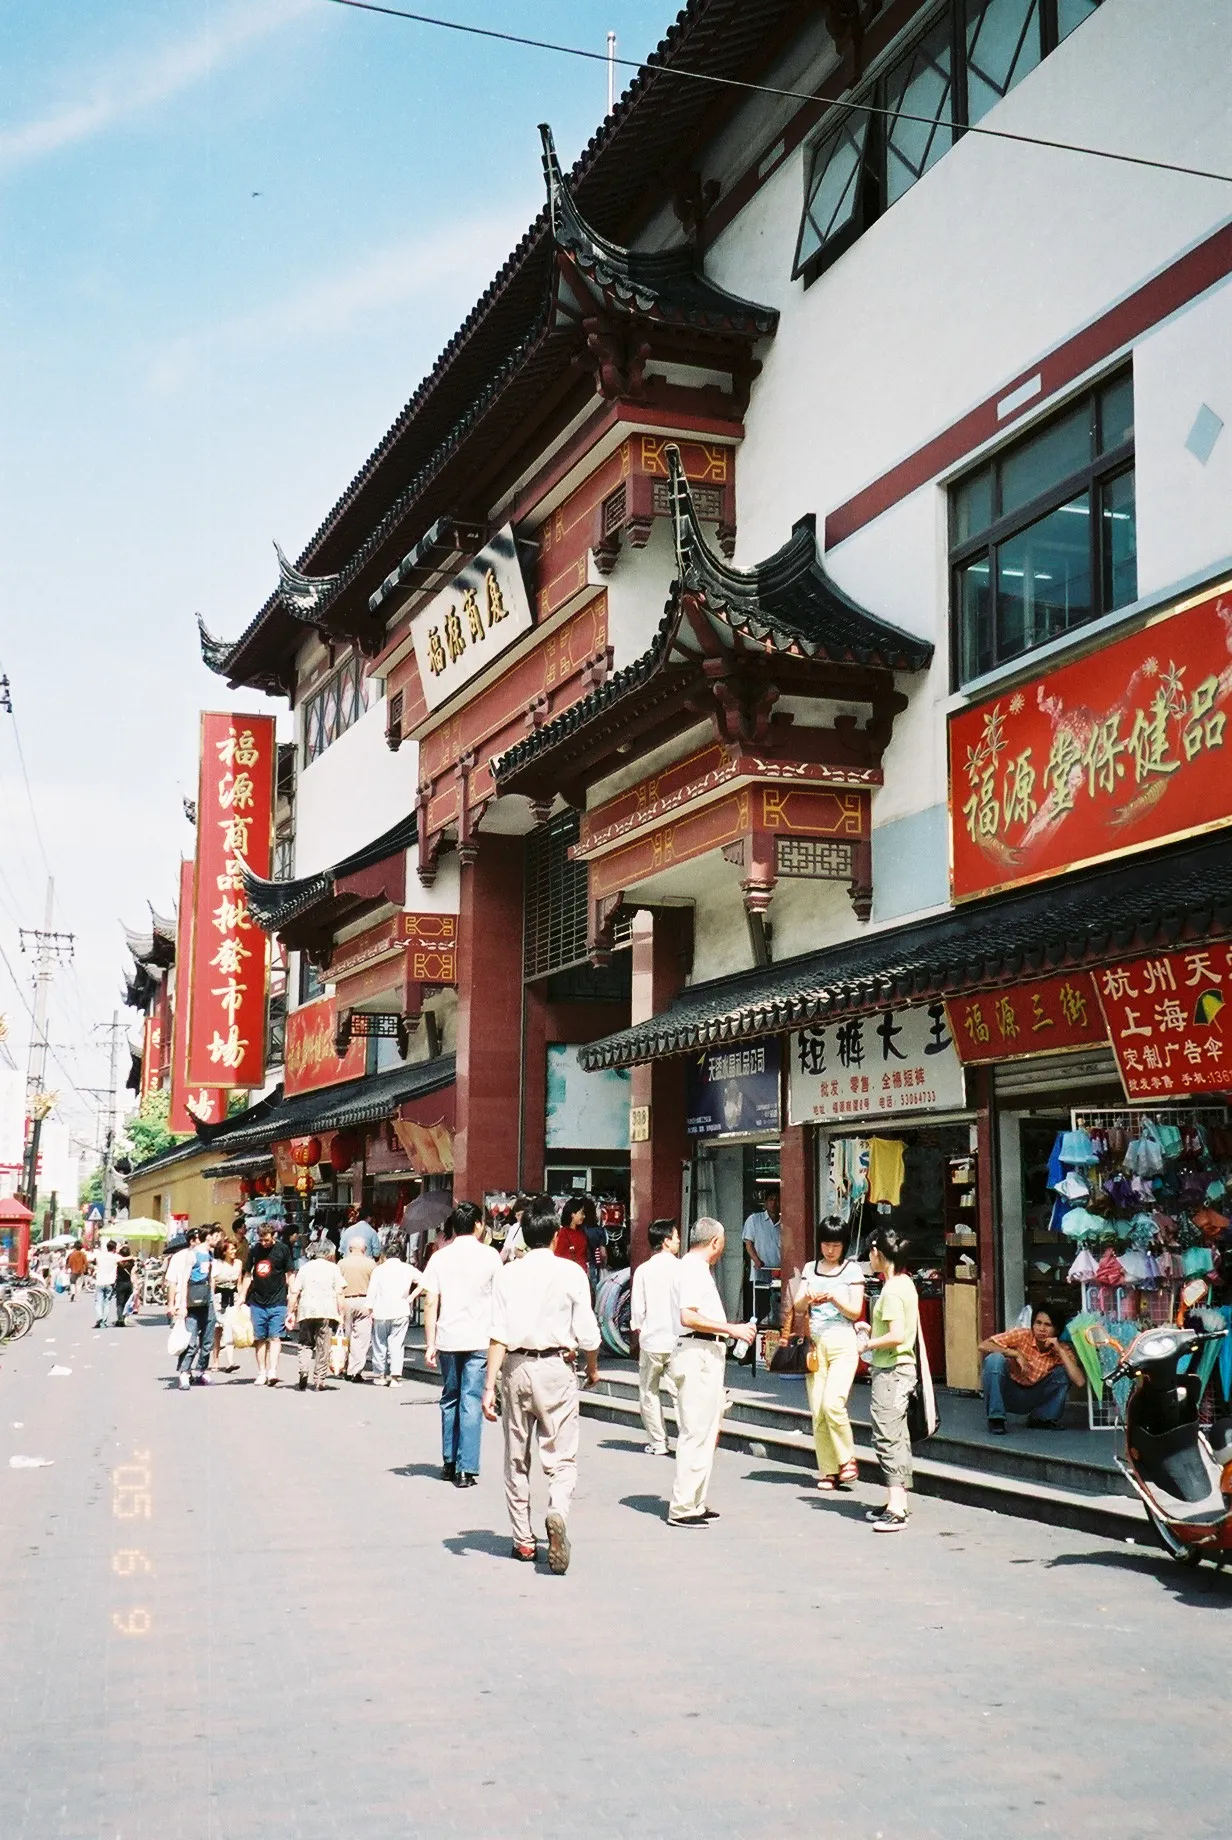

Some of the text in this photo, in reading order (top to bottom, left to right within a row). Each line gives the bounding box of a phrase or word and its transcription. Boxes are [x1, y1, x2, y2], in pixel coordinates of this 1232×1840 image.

[962, 673, 1228, 843] 福源堂保健品
[206, 727, 259, 1069] 福源商品批發市場
[1102, 946, 1232, 1001] 杭州天
[1120, 998, 1189, 1039] 上海
[1122, 1036, 1224, 1071] 定制广告伞
[1181, 1070, 1232, 1087] 手机:136
